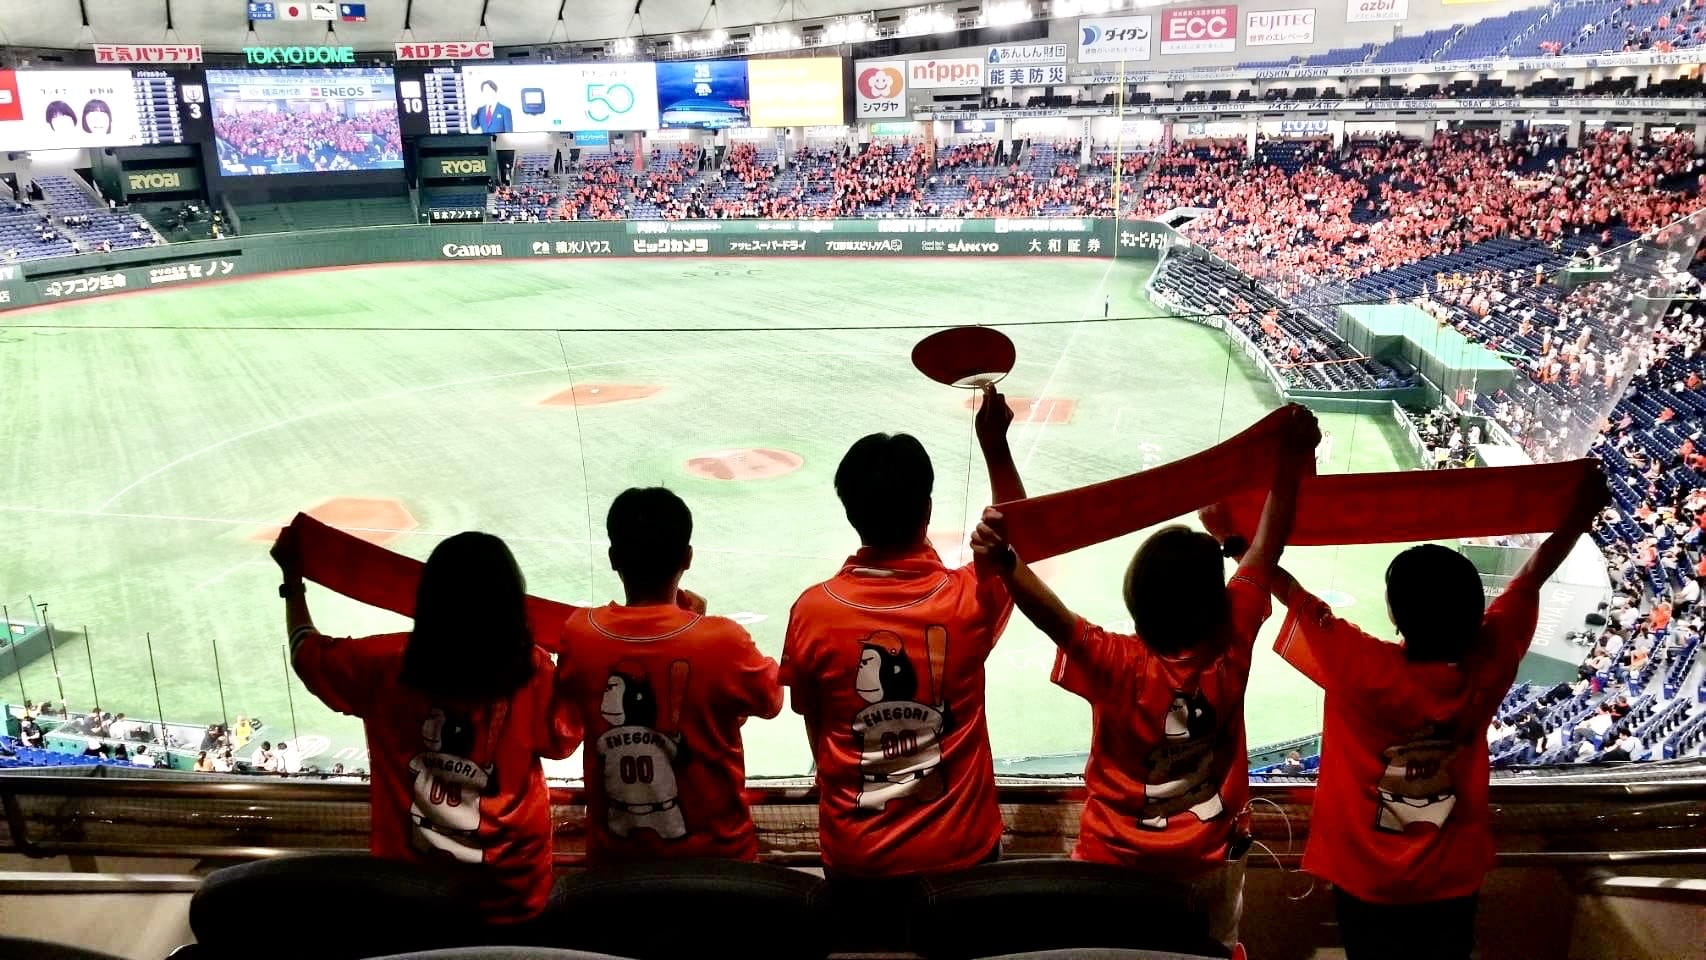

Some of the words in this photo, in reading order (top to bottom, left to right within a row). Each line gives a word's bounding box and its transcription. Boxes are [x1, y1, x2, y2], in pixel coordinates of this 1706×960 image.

[1360, 0, 1396, 11] azbil
[1170, 16, 1227, 39] ECC
[1249, 14, 1312, 30] FUJITEC
[1105, 27, 1148, 41] ダイダン
[1249, 33, 1310, 43] 世界のエレベータ
[97, 46, 200, 61] 元気ハツラツ!
[242, 47, 304, 64] TOKYO
[305, 47, 355, 63] DOME
[399, 43, 490, 58] オロナミンC
[1000, 45, 1065, 59] あんしん財団
[913, 61, 979, 81] nippn
[990, 67, 1063, 84] 能美防災
[321, 87, 364, 97] ENEOS
[190, 103, 202, 119] 3
[403, 99, 422, 114] 10
[863, 102, 899, 113] シマダヤ
[441, 160, 487, 174] RYOBI
[129, 173, 180, 190] RYOBI
[433, 210, 481, 219] 日本アンテナ
[442, 243, 503, 258] Canon
[556, 240, 612, 254] 積水ハウス
[634, 239, 709, 252] ビックカメラ
[947, 239, 999, 252] SANKYO
[1028, 238, 1101, 252] 大和証券
[188, 260, 234, 278] セノン
[62, 273, 127, 295] フコク生命
[864, 707, 928, 728] ENEGORI
[620, 755, 653, 785] 00
